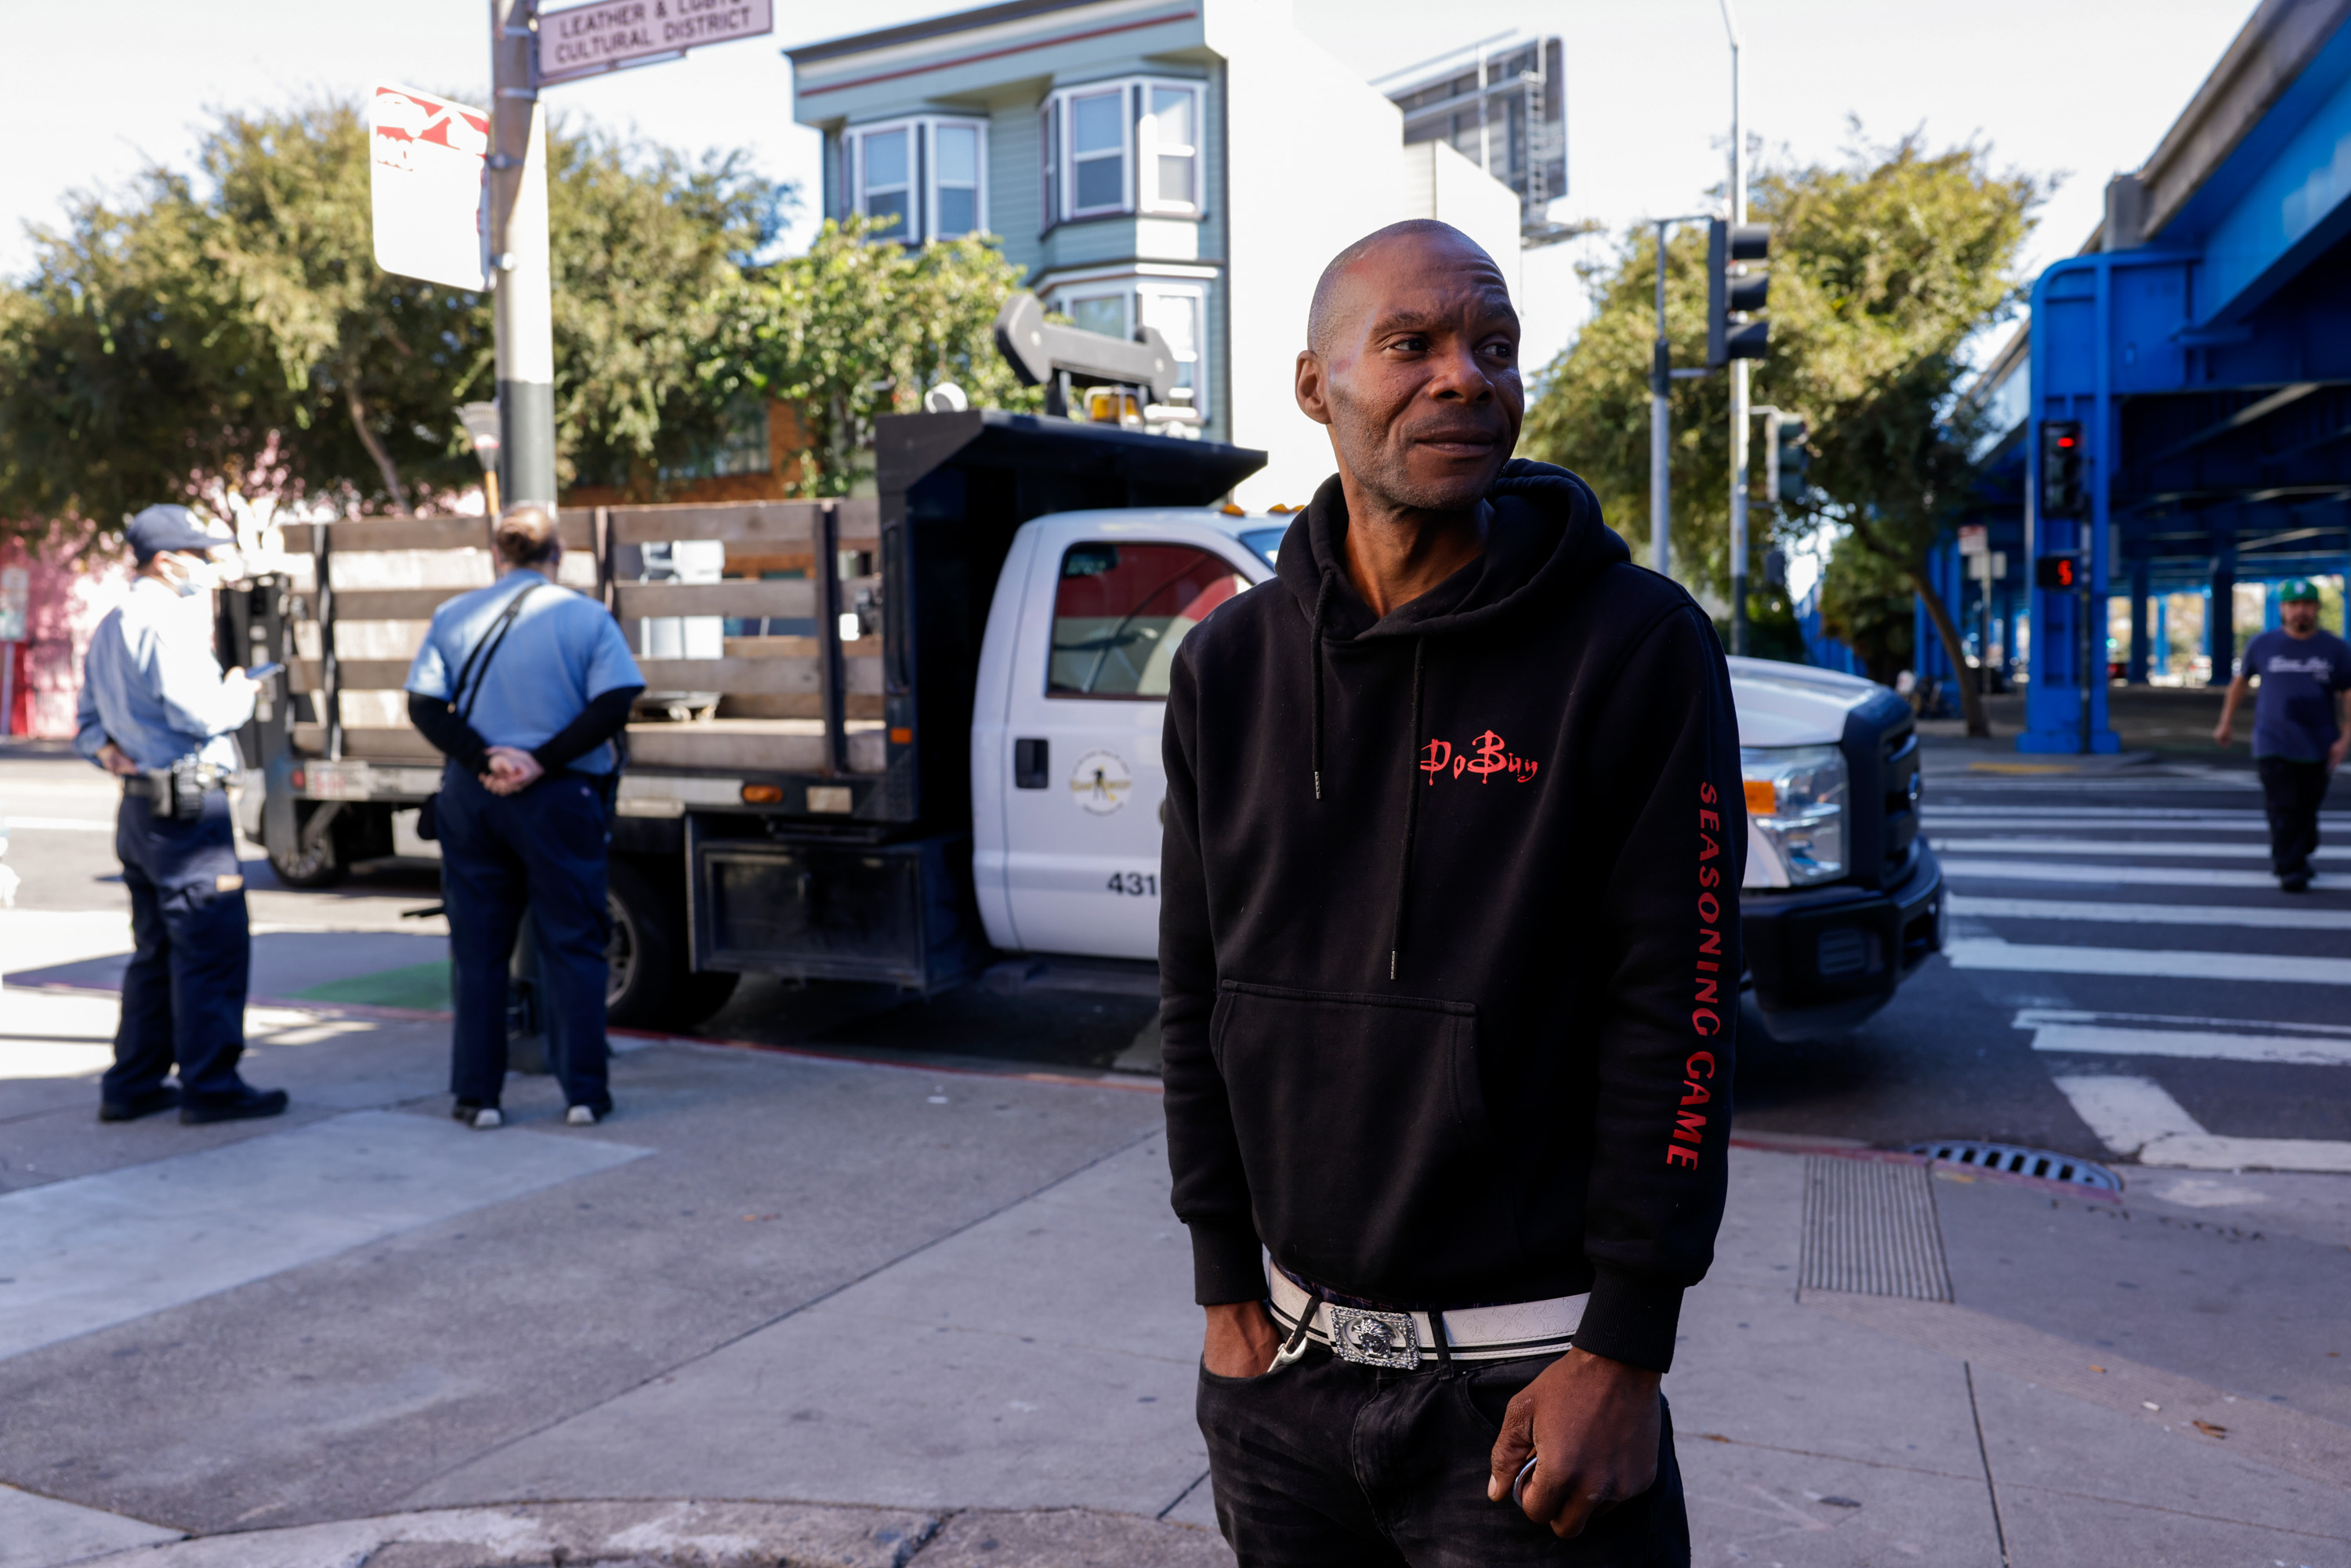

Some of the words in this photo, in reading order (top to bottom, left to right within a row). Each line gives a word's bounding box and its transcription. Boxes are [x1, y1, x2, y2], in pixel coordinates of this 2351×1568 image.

[555, 28, 654, 63] CULTURAL
[665, 7, 752, 42] DISTRICT
[559, 2, 646, 38] LEATHER
[654, 2, 668, 20] &
[1107, 872, 1156, 896] 431
[1691, 781, 1722, 1037] SEASONING
[1666, 1050, 1716, 1171] GAME
